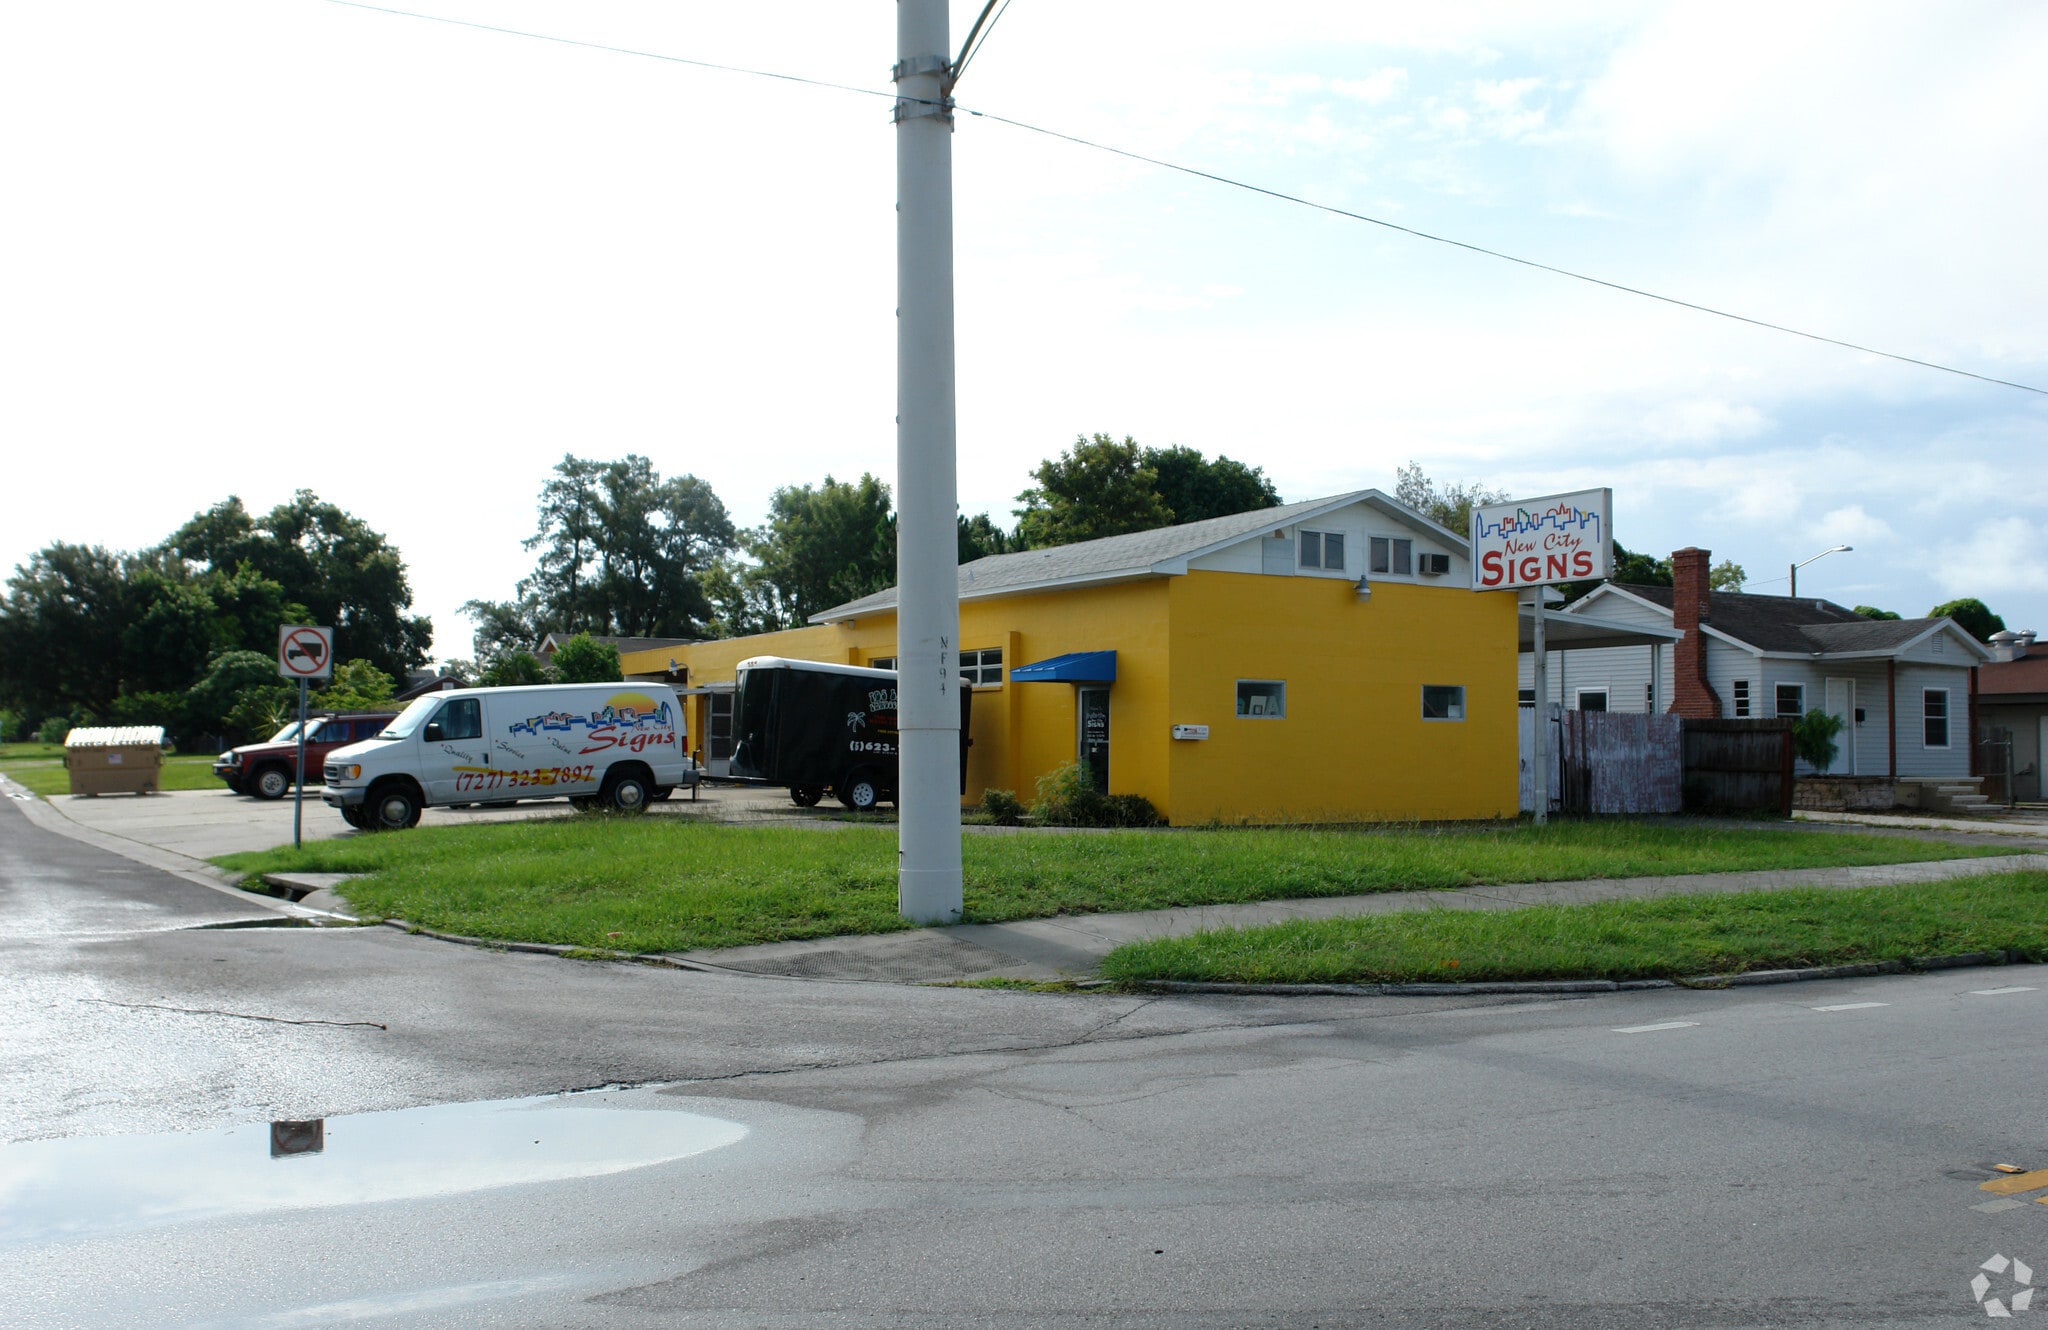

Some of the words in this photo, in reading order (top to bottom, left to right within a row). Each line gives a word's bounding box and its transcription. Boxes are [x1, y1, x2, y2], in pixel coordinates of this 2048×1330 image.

[1504, 538, 1537, 556] New
[1543, 532, 1583, 553] City
[1481, 550, 1593, 586] SIGNS
[496, 741, 526, 760] Service
[578, 725, 676, 754] Signs
[444, 744, 473, 764] Quality
[455, 769, 503, 792] (727)
[508, 765, 594, 787] 323-7897
